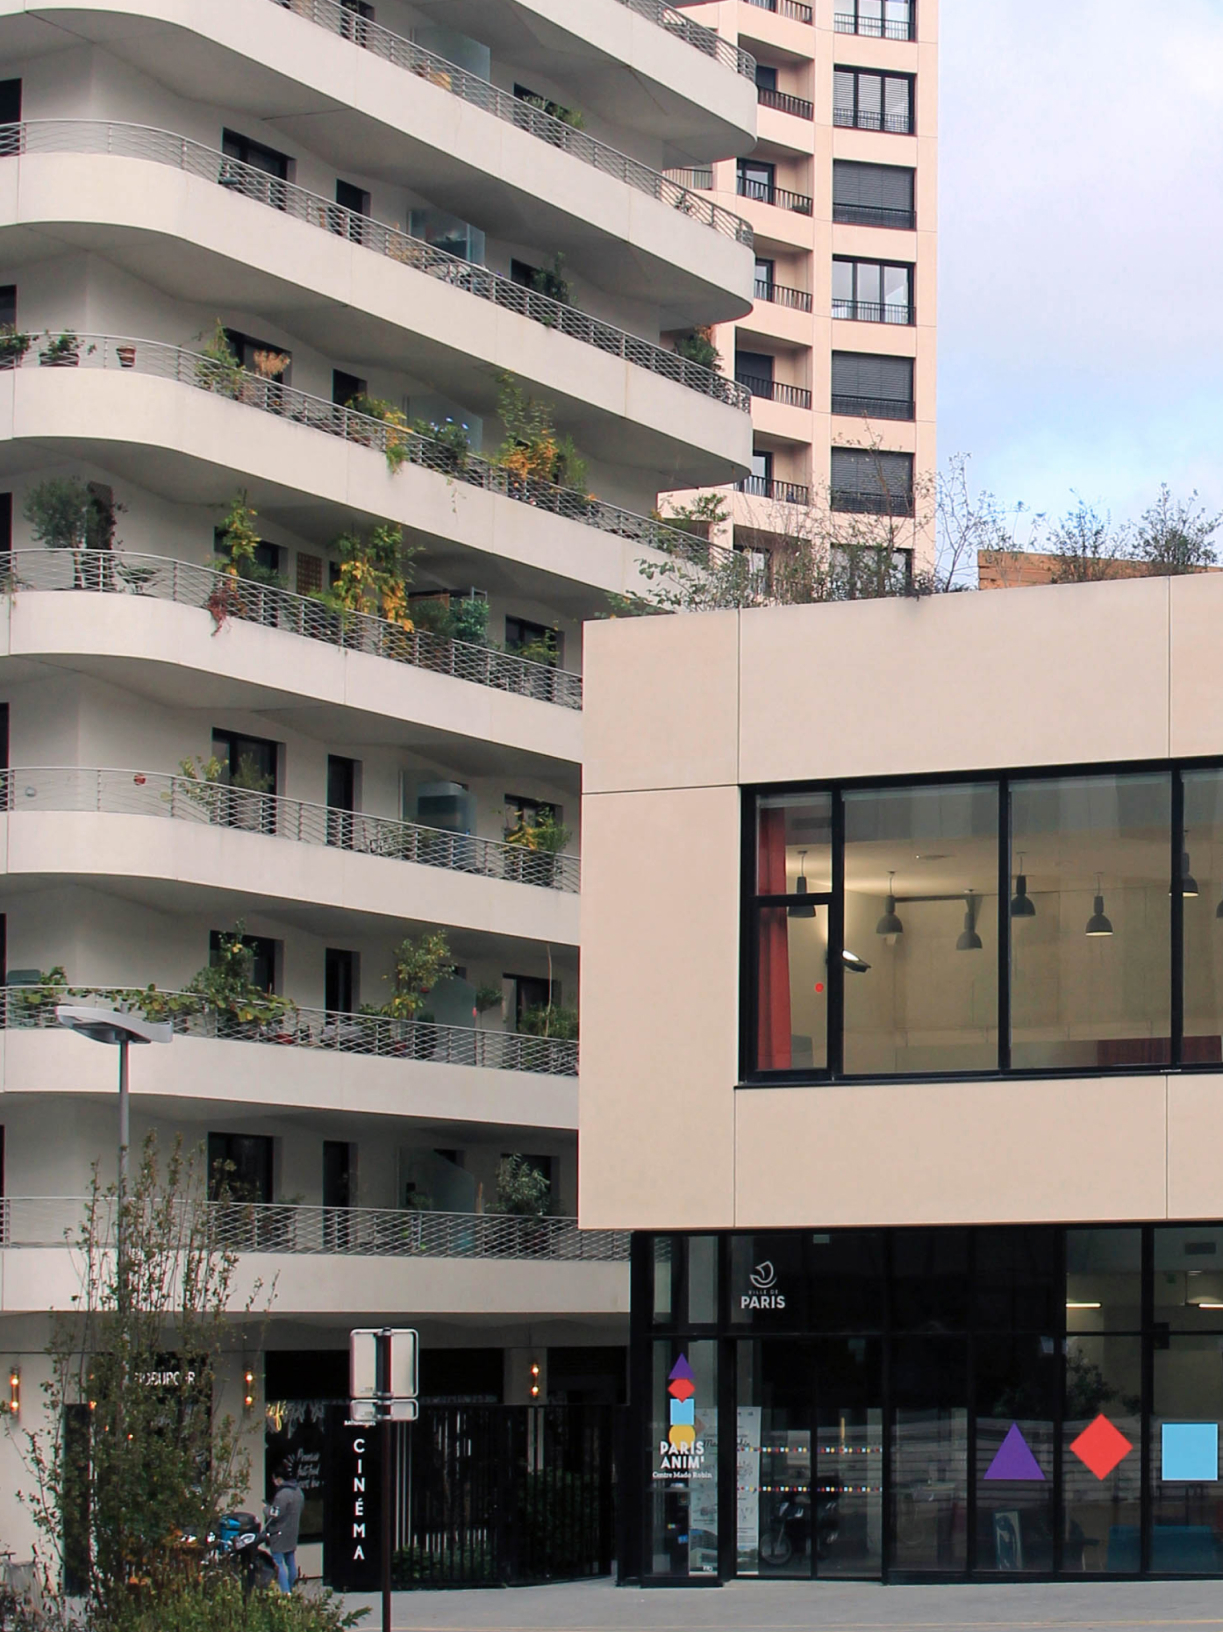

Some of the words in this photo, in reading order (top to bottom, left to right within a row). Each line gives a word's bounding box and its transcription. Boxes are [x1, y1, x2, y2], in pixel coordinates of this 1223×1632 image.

[741, 1296, 786, 1309] PARIS
[660, 1441, 705, 1455] PARIS
[660, 1456, 705, 1469] ANIM'
[353, 1438, 366, 1560] CINÉMA
